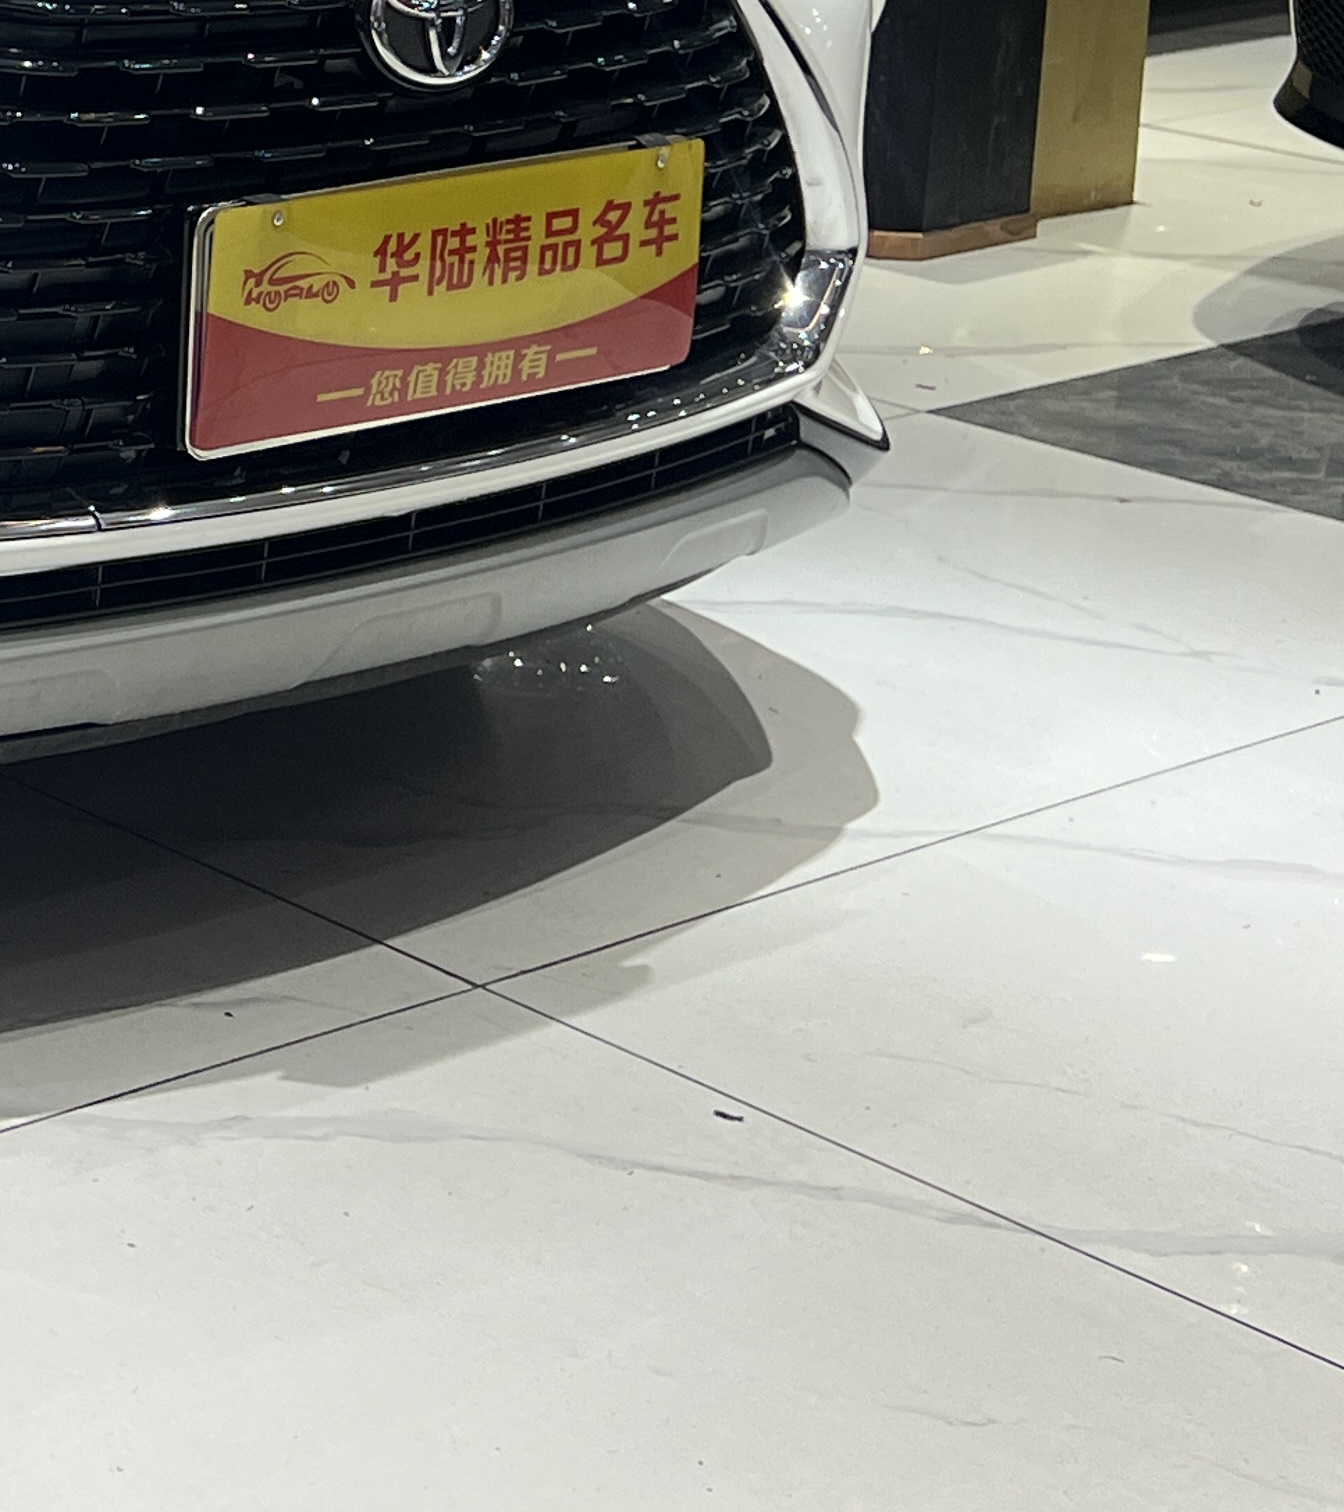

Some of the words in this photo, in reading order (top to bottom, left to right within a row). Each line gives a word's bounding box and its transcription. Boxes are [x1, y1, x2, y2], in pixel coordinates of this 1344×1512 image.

[369, 190, 682, 304] 华陆精品名车
